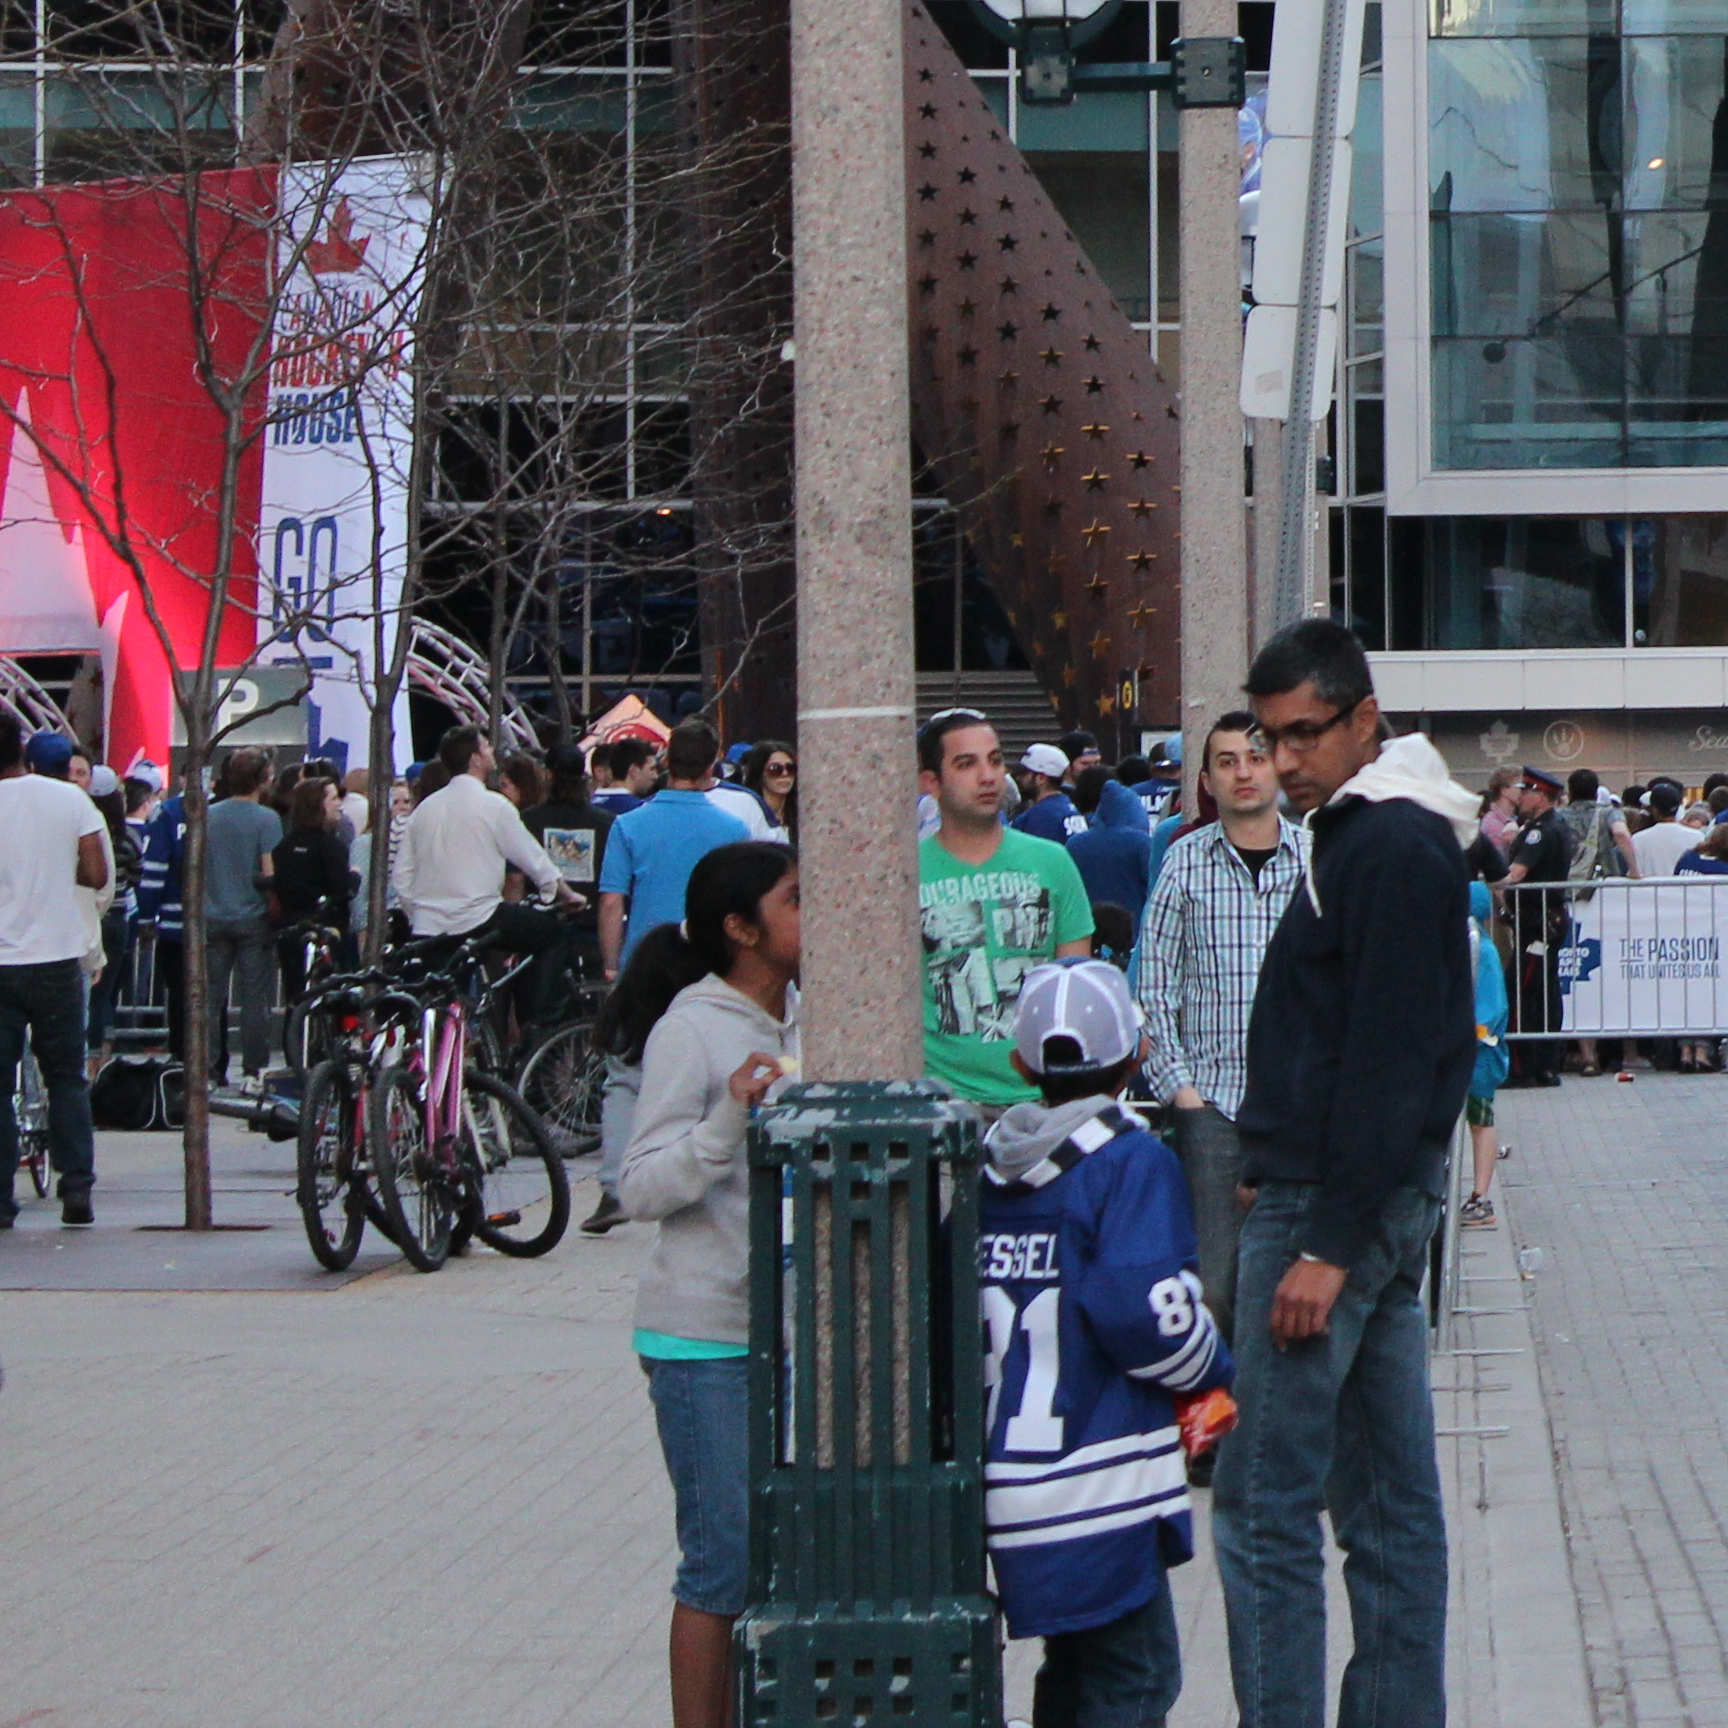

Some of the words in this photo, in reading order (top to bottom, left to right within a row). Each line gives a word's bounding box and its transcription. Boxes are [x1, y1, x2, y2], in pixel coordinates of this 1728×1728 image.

[273, 517, 338, 644] GO
[1619, 938, 1644, 959] THE
[1648, 936, 1720, 962] PASSION
[1620, 963, 1646, 980] THAT
[1648, 962, 1686, 979] UNITES
[1686, 961, 1701, 978] US
